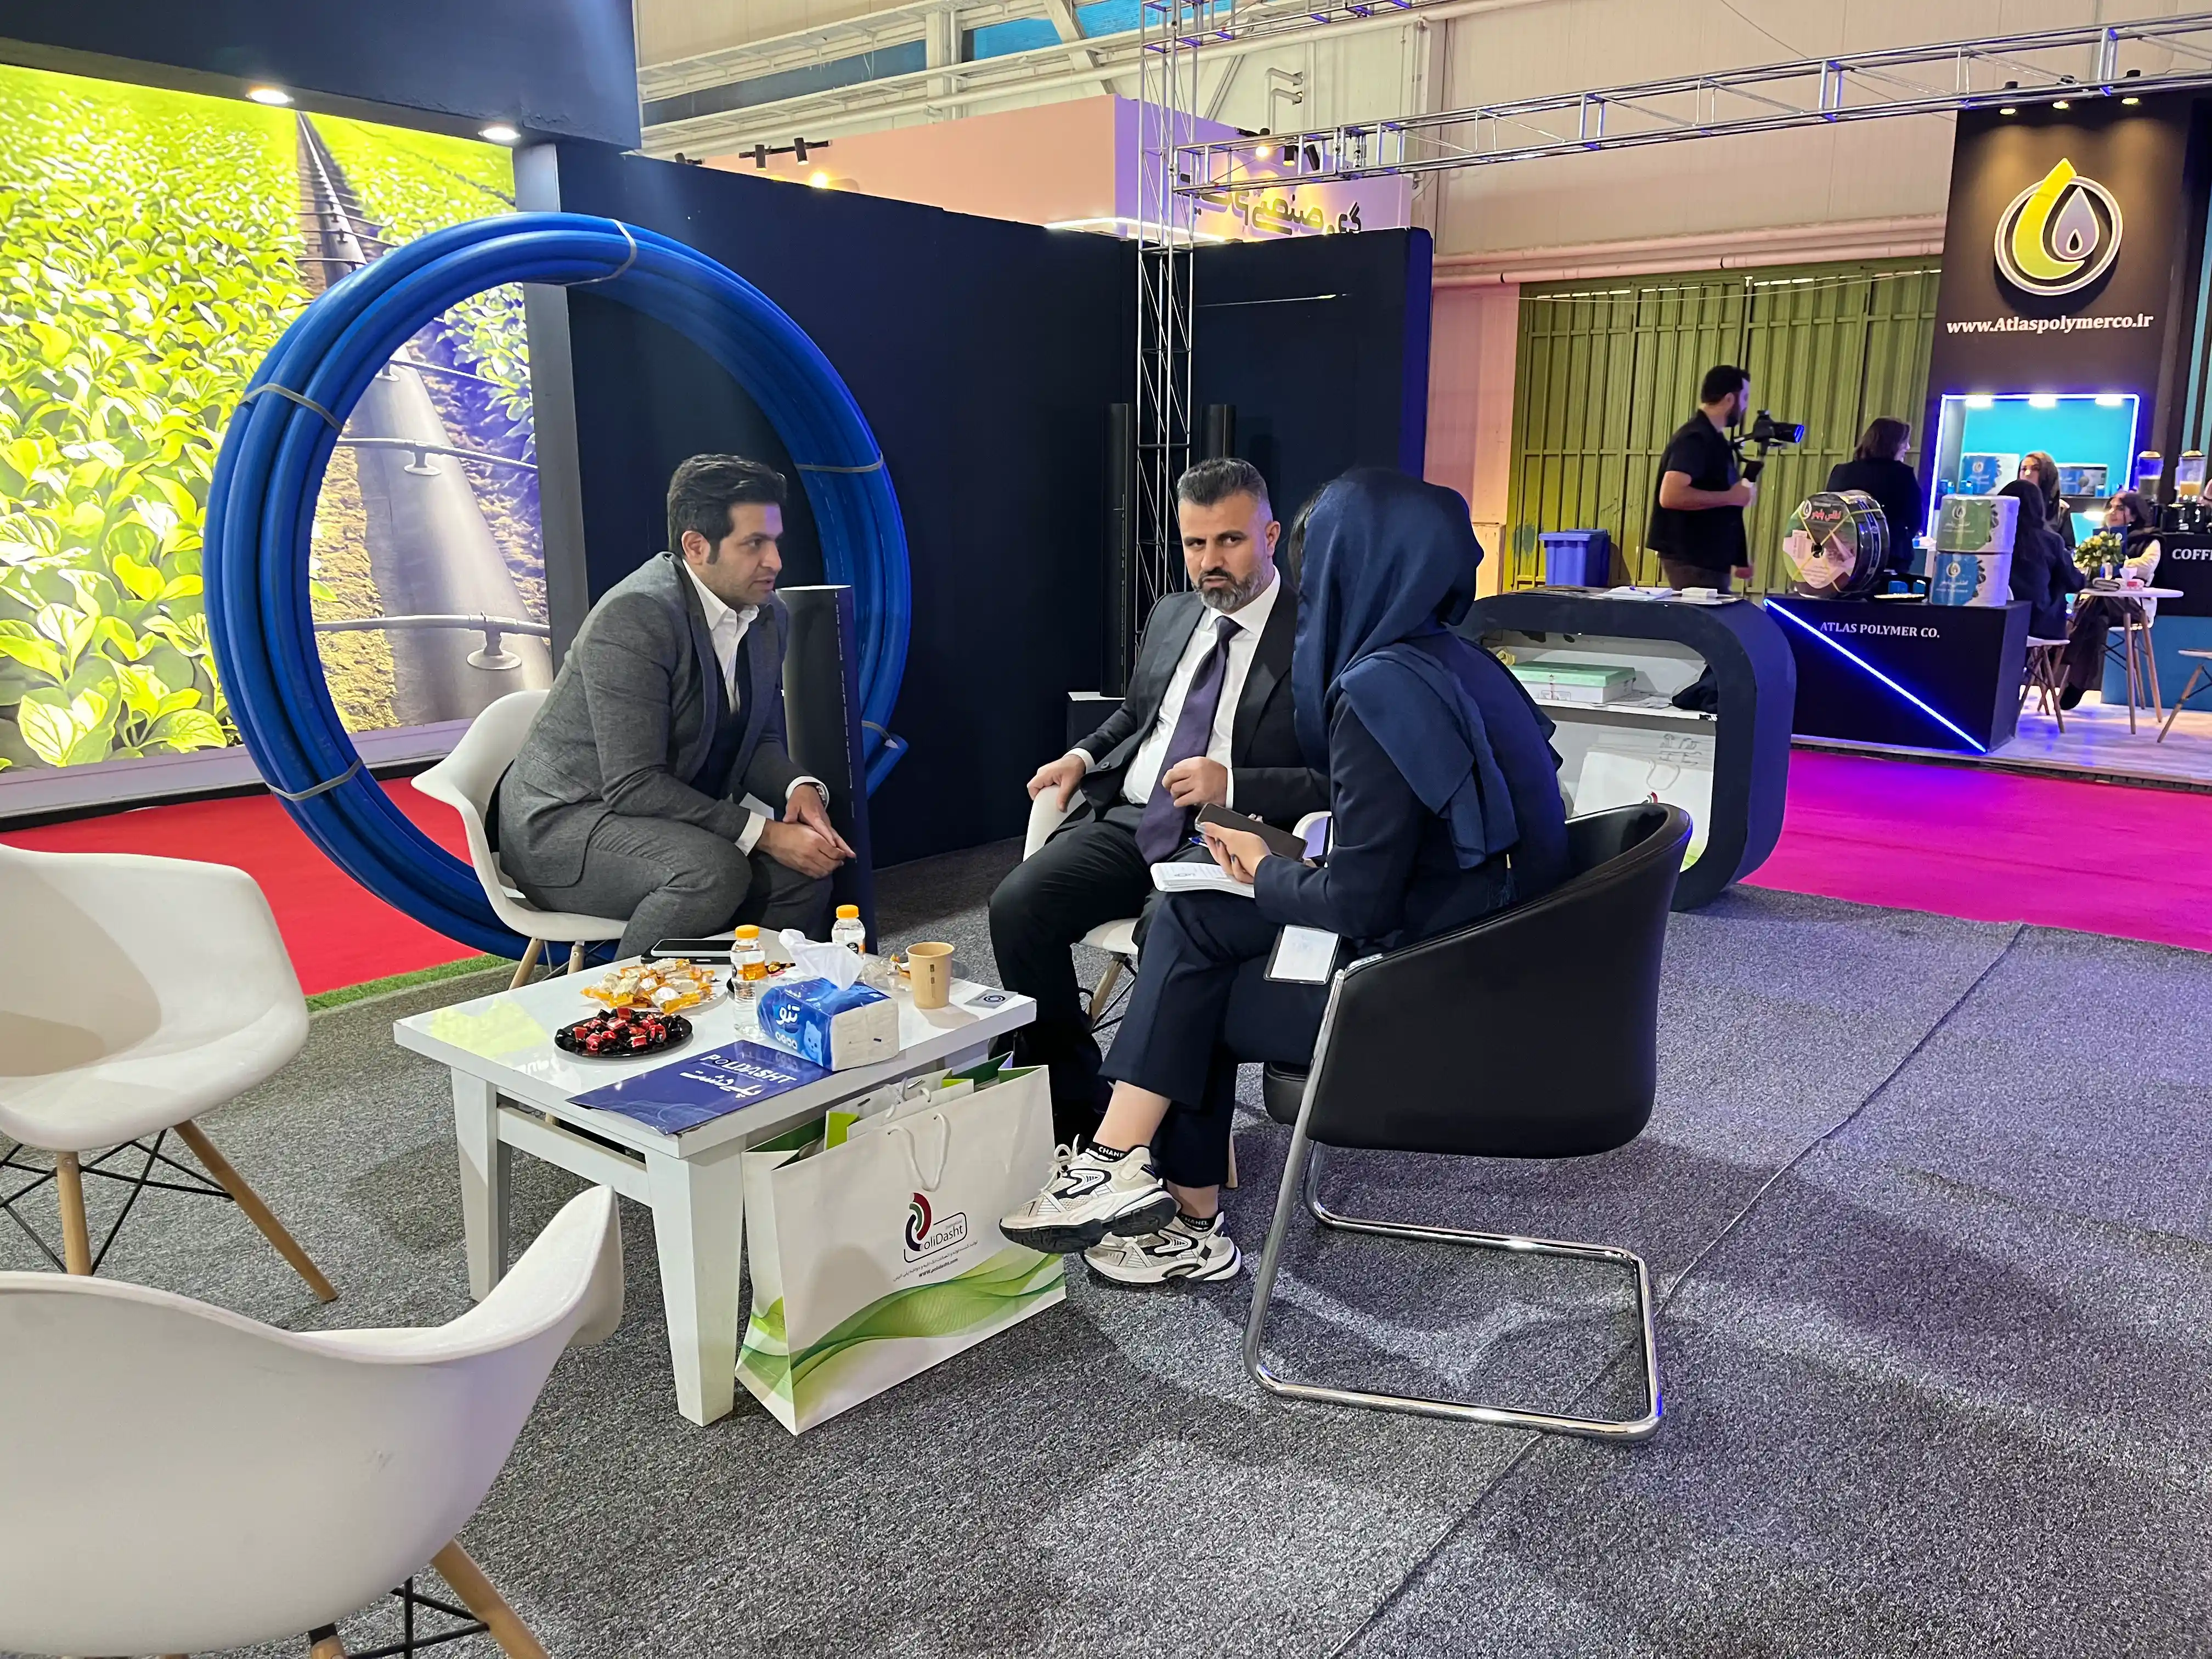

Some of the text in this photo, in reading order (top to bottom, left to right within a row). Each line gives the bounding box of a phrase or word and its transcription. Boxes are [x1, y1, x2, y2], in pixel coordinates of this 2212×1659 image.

[1946, 313, 2154, 334] www.Atlaspolymerco.ir
[2172, 549, 2212, 560] COFF
[1820, 622, 1940, 638] ATLAS POLYMER CO.
[776, 1004, 800, 1025] تنو
